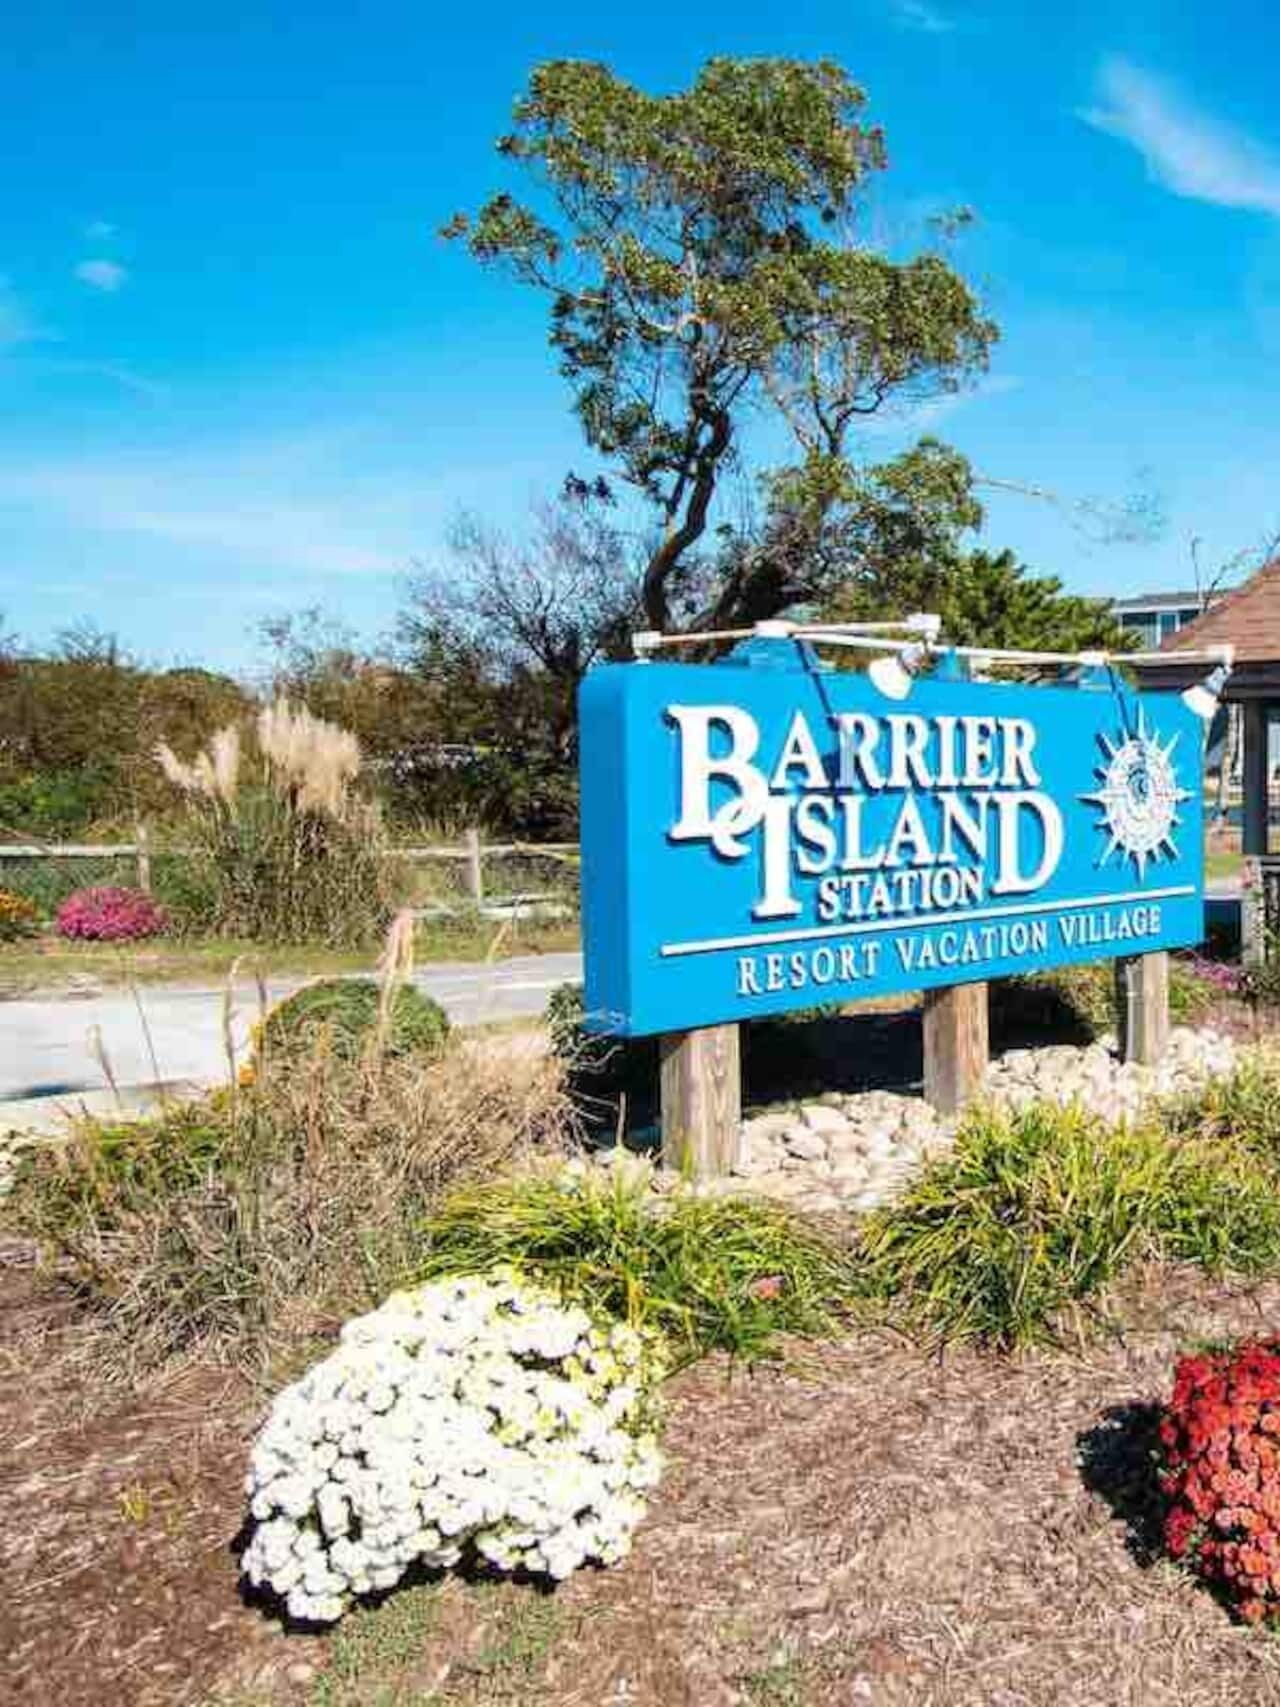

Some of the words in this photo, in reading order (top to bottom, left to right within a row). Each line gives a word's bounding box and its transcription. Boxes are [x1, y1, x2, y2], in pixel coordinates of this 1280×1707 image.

[666, 703, 1041, 858] BARRIER
[752, 790, 1064, 917] ISLAND
[818, 867, 984, 921] STATION
[738, 939, 879, 996] RESORT
[896, 921, 1048, 973] VACATION
[1059, 904, 1162, 947] VILLAGE
